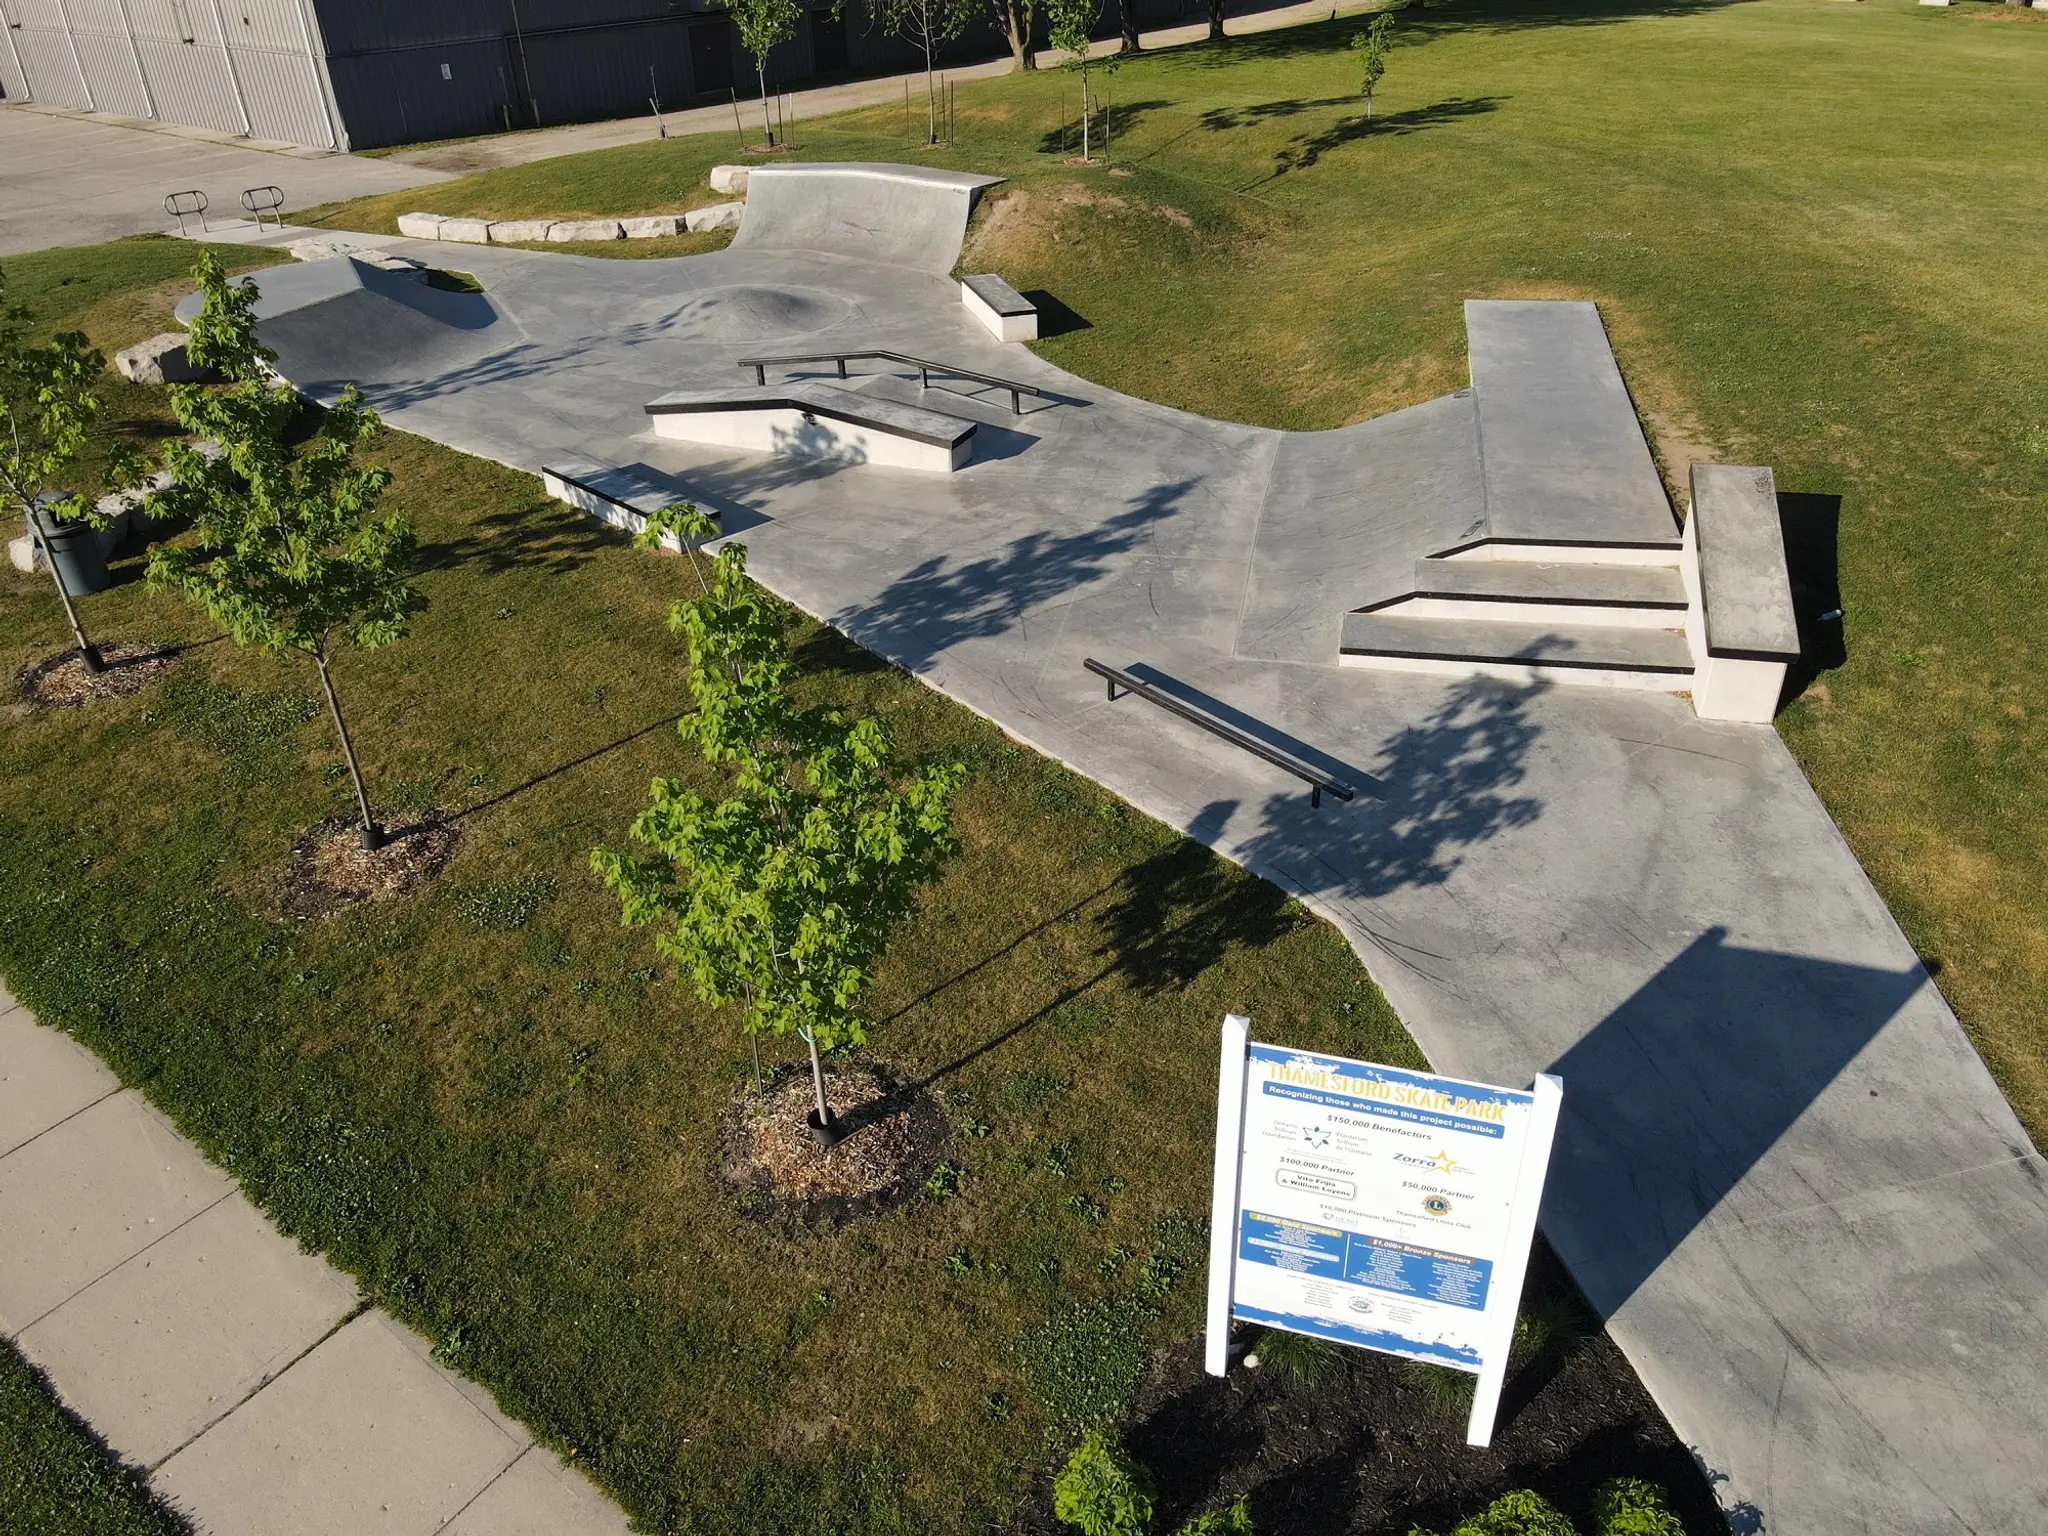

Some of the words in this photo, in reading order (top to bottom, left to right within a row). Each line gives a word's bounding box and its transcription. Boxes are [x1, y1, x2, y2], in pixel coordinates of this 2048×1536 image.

[1269, 1063, 1391, 1100] THAMESFORD
[1395, 1084, 1453, 1112] SKATE
[1455, 1096, 1506, 1122] PARK
[1269, 1085, 1324, 1102] Recognizing
[1325, 1096, 1351, 1107] those
[1352, 1101, 1372, 1111] who
[1373, 1105, 1399, 1116] made
[1400, 1109, 1418, 1120] this
[1420, 1115, 1453, 1127] project
[1454, 1121, 1498, 1135] possible:
[1327, 1114, 1369, 1128] $150,000
[1371, 1122, 1431, 1139] Benefactors
[1279, 1156, 1319, 1168] $100,000
[1321, 1164, 1355, 1176] Partner
[1392, 1152, 1436, 1167] Zorra
[1290, 1179, 1319, 1190] William
[1401, 1180, 1437, 1192] $50,000
[1439, 1188, 1475, 1200] Partner
[1347, 1208, 1379, 1220] Platinum
[1382, 1216, 1416, 1227] Sponsors
[1455, 1221, 1471, 1229] Club
[1404, 1245, 1431, 1256] Bronze
[1433, 1251, 1470, 1264] Sponsors
